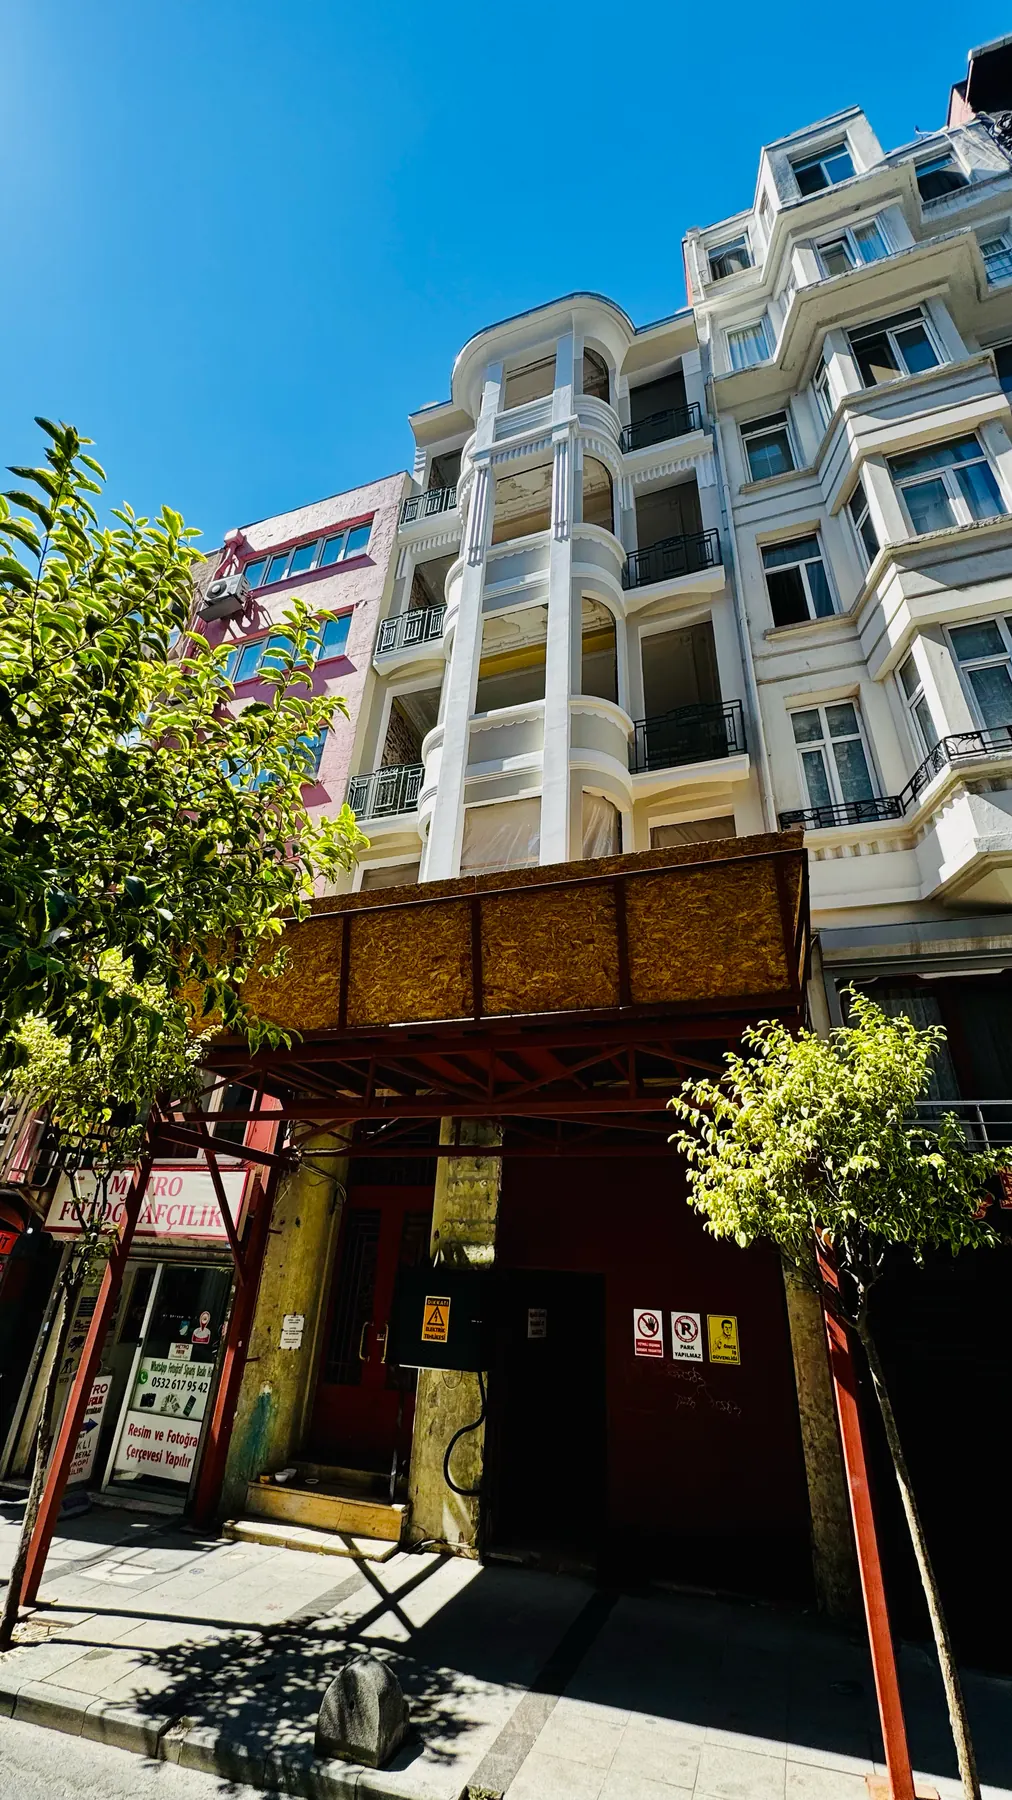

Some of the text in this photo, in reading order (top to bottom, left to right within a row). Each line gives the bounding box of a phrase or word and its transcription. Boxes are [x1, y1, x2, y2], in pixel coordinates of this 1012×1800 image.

[108, 1175, 183, 1197] MTRO
[674, 1351, 702, 1359] YAPILMAZ
[152, 1376, 209, 1394] 0532 617 95 42
[127, 1423, 198, 1449] Resim ve Fotoğra
[126, 1444, 192, 1469] Çerçevesi Yapılır
